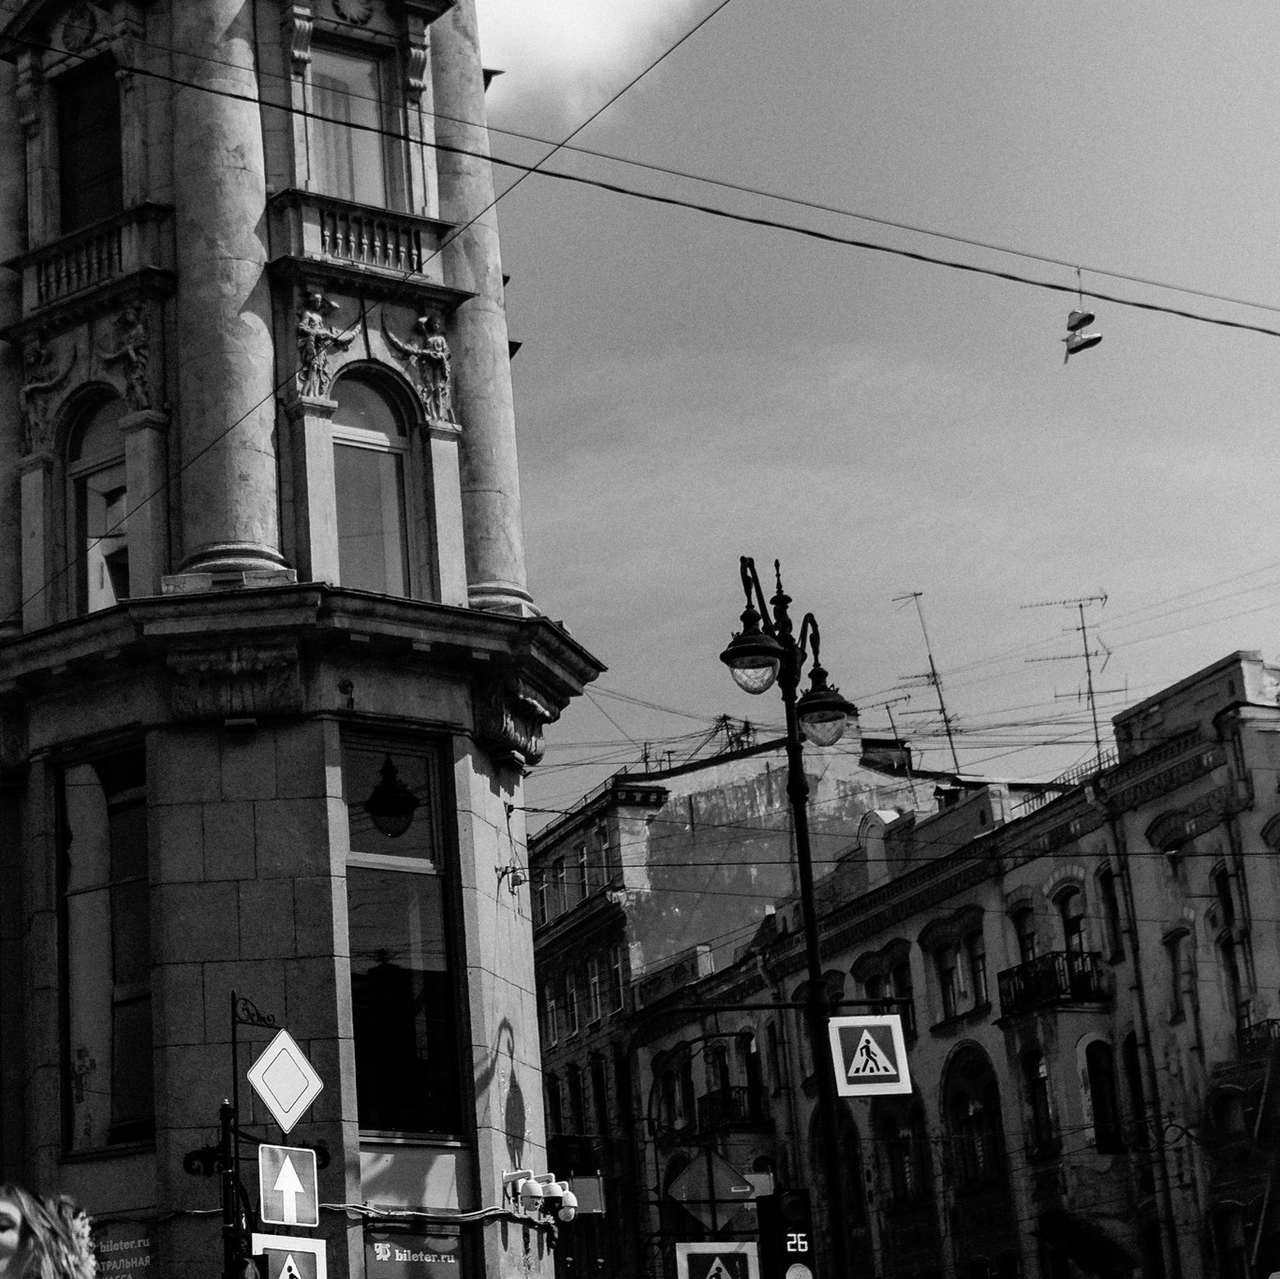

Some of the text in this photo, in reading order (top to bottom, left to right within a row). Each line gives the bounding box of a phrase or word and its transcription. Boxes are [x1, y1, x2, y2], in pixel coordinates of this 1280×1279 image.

[786, 1233, 808, 1252] 26
[96, 1255, 151, 1271] АТРАЛЬНАЯ
[394, 1249, 455, 1263] bileter.ru
